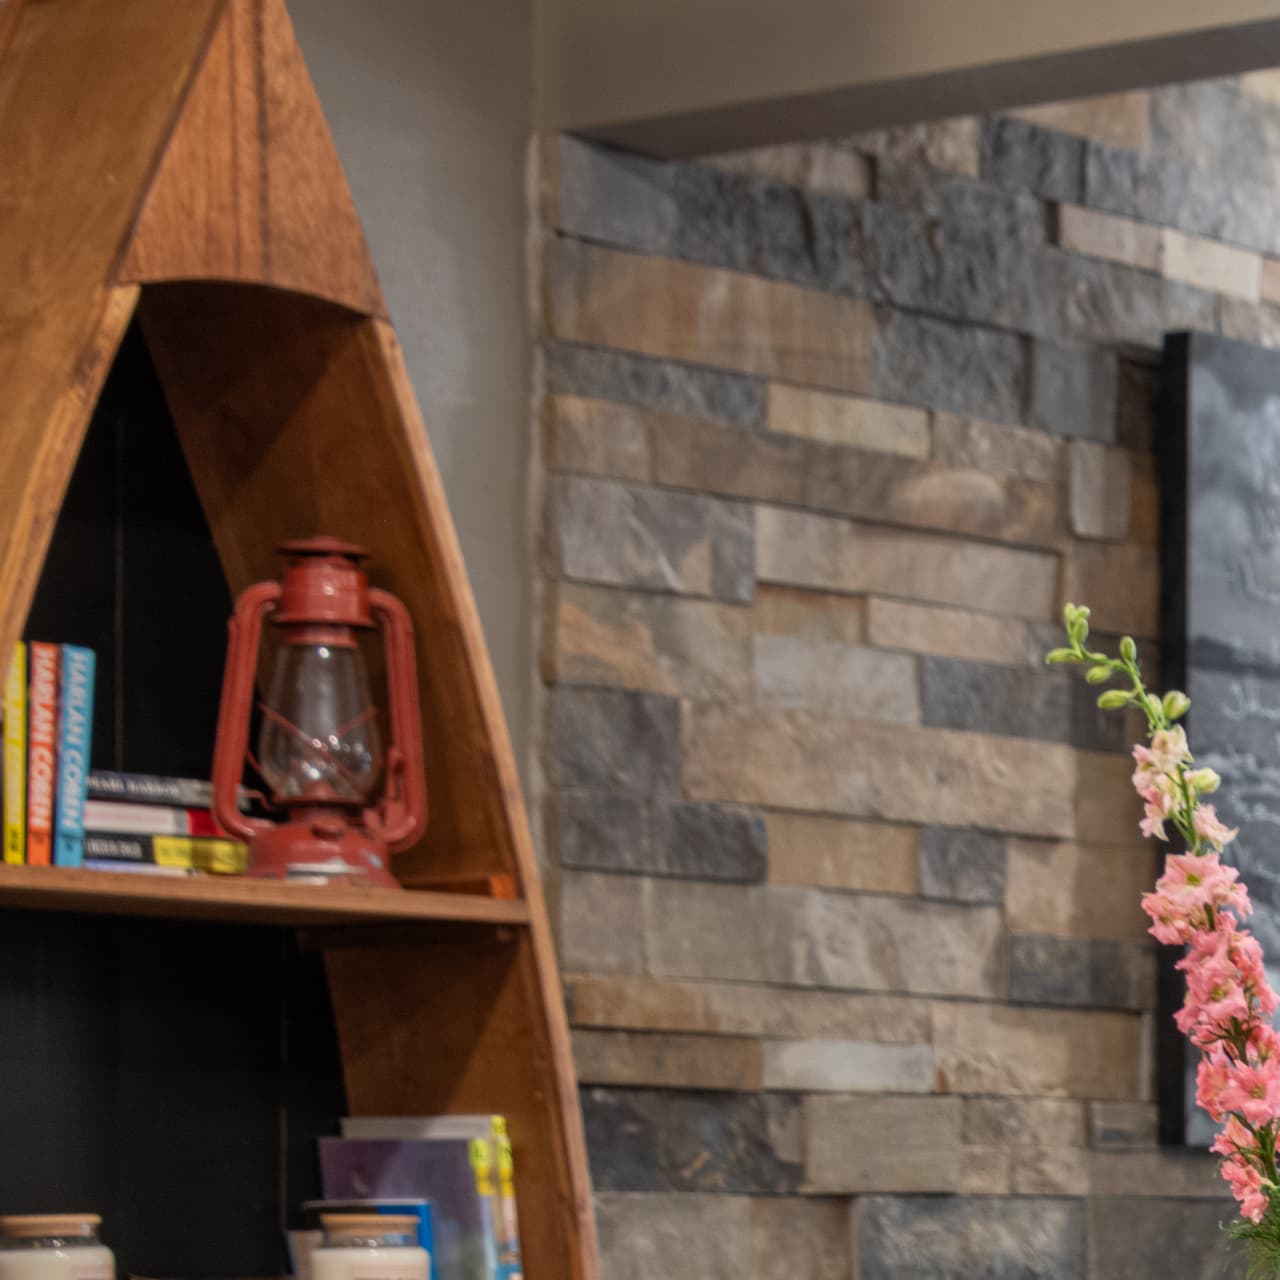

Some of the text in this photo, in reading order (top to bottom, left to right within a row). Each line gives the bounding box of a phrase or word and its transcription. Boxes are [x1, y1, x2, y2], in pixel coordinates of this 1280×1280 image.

[30, 645, 56, 828] HARLAN COBEN
[63, 651, 88, 829] HARLAN COBEN
